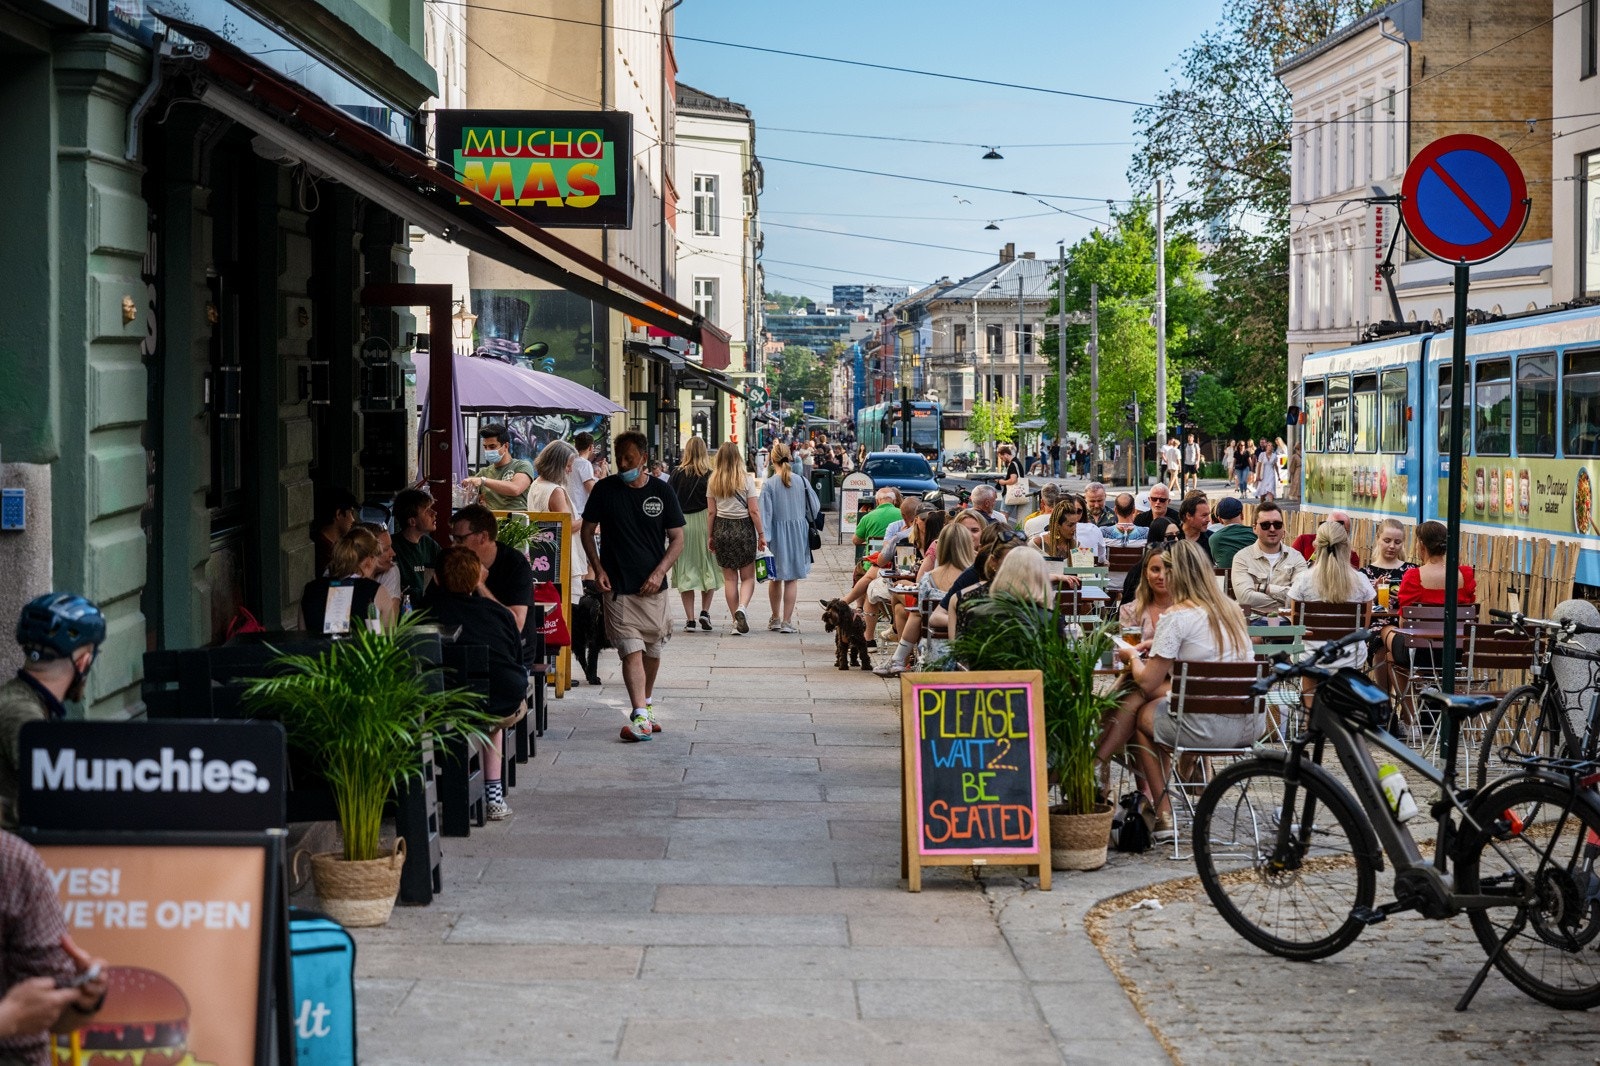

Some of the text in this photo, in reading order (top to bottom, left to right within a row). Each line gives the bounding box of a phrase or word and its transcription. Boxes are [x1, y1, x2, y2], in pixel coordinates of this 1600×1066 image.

[463, 129, 603, 158] MUCHO
[458, 160, 600, 208] MAS
[1375, 206, 1384, 259] EVENSEN
[750, 389, 765, 404] SX
[919, 689, 1028, 740] PLEASE
[30, 747, 270, 793] Munchies.
[931, 737, 1019, 771] WAIT 2
[961, 771, 1000, 803] BE
[925, 799, 1035, 844] SEATED
[46, 867, 121, 897] YES!
[64, 899, 252, 930] E'RE OPEN
[294, 998, 332, 1040] lt
